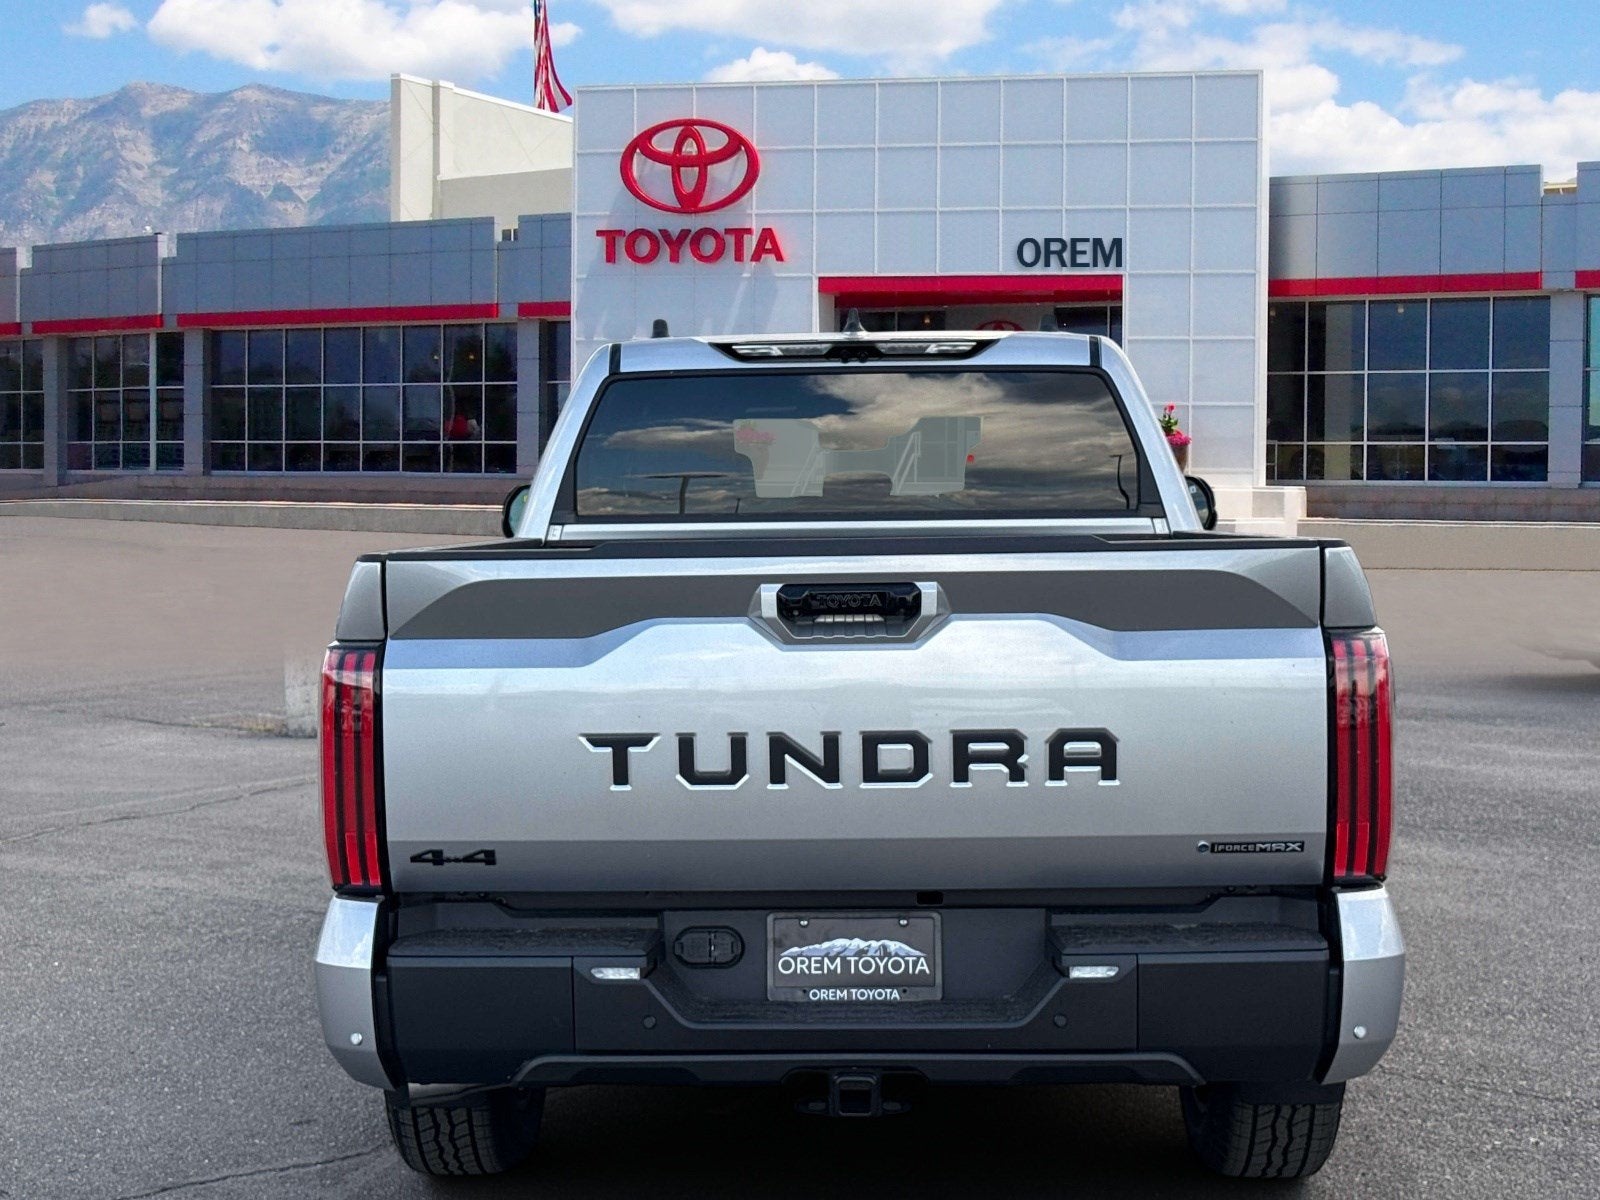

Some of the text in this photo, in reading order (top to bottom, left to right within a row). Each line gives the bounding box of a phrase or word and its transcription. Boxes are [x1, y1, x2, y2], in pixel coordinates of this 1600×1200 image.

[596, 227, 785, 264] TOYOTA
[1016, 237, 1123, 268] OREM
[816, 593, 882, 608] TOYOTA
[578, 728, 1120, 790] TUNDRA
[778, 956, 930, 974] OREM TOYOTA
[809, 989, 900, 1000] OREM TOYOTA
